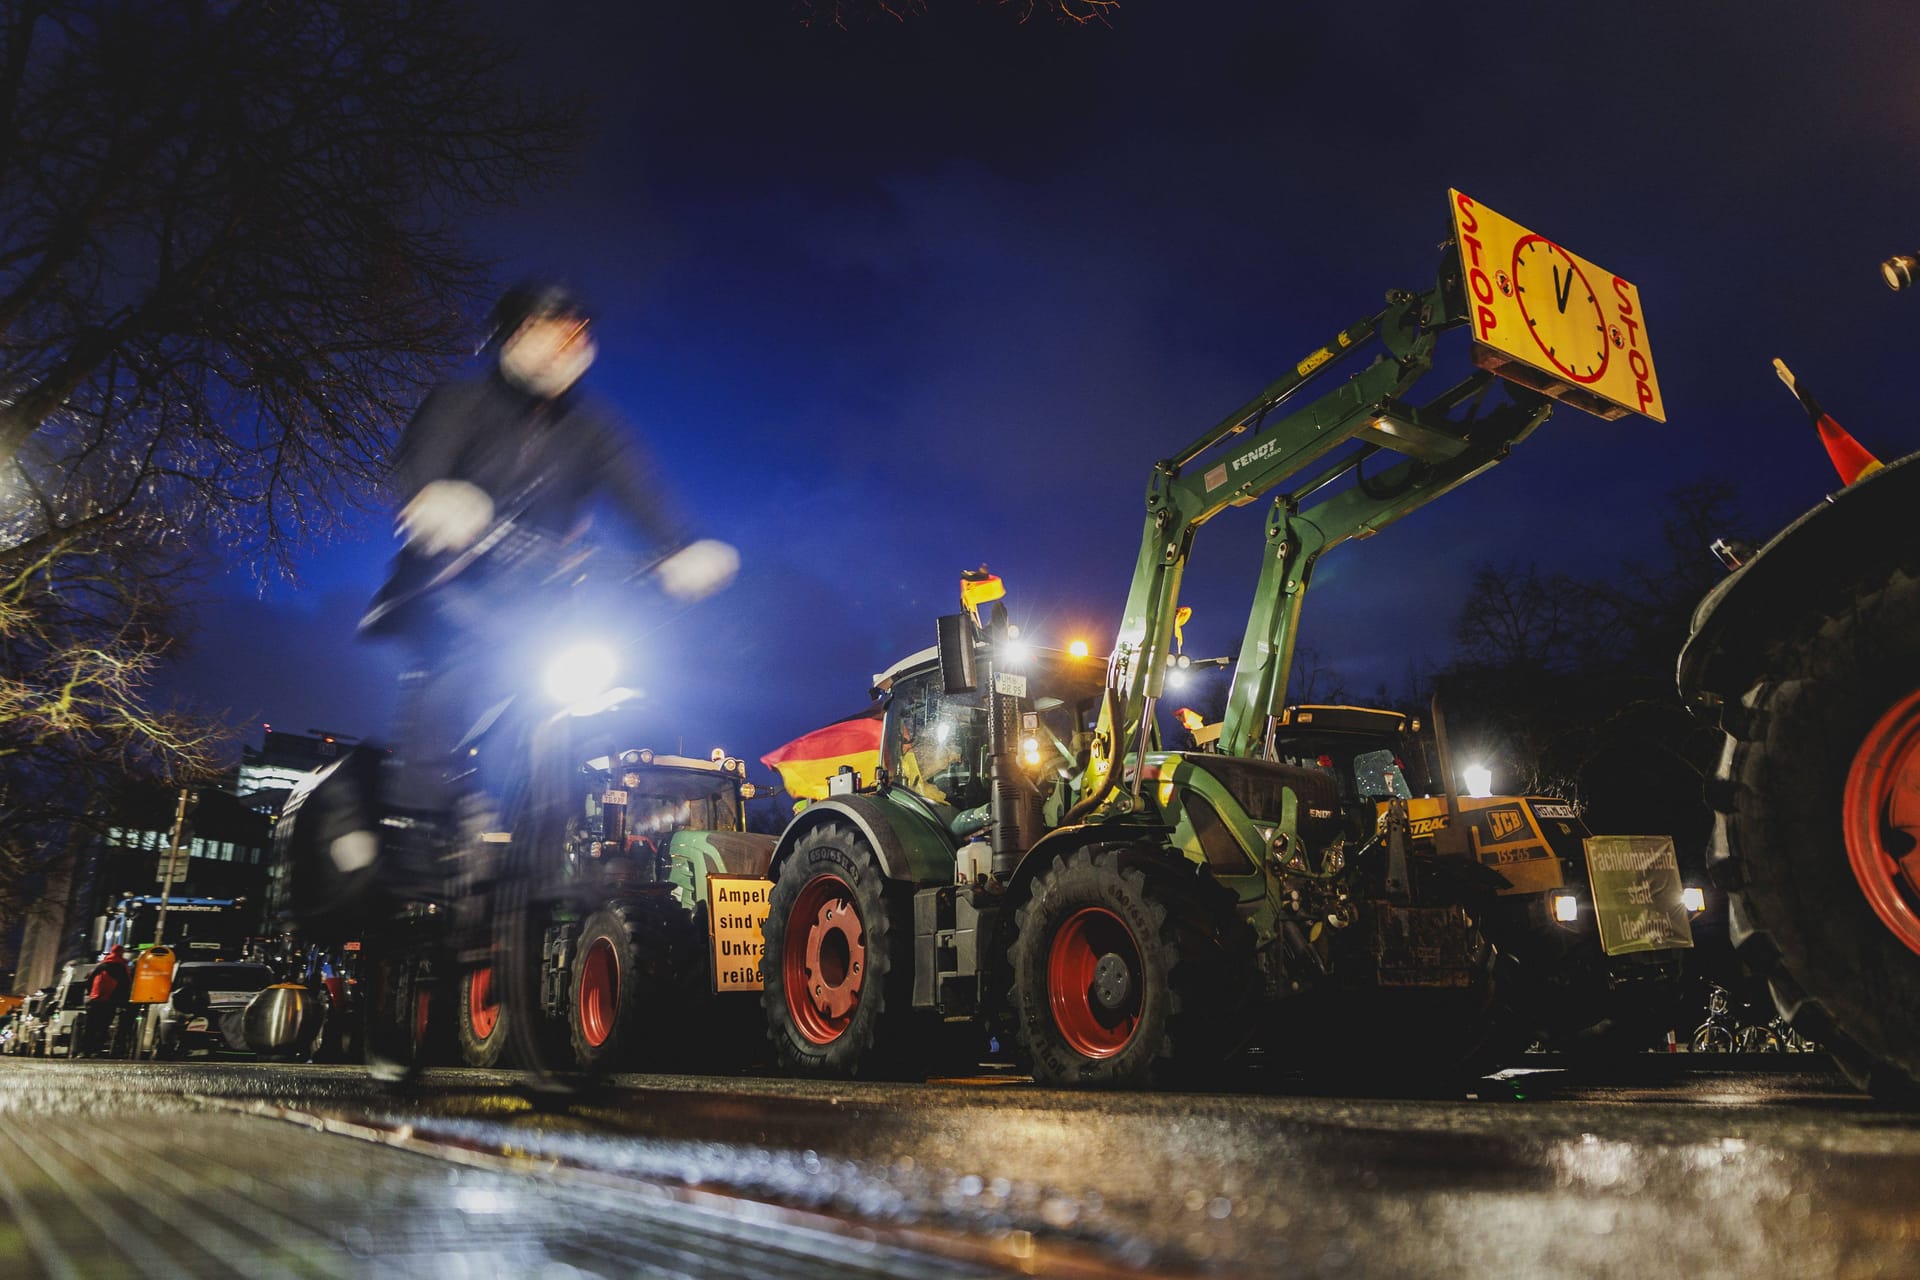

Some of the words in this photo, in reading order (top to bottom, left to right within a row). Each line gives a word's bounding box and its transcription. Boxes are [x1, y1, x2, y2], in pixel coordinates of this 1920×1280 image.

[1457, 193, 1497, 341] STOP
[1612, 276, 1654, 413] STOP
[1231, 438, 1277, 471] FENDT
[1491, 811, 1521, 838] JCB
[1589, 846, 1676, 877] Fachkompetenz
[718, 887, 770, 906] Ampel
[1627, 880, 1654, 905] statt
[719, 913, 753, 929] sind
[722, 967, 764, 983] reiße
